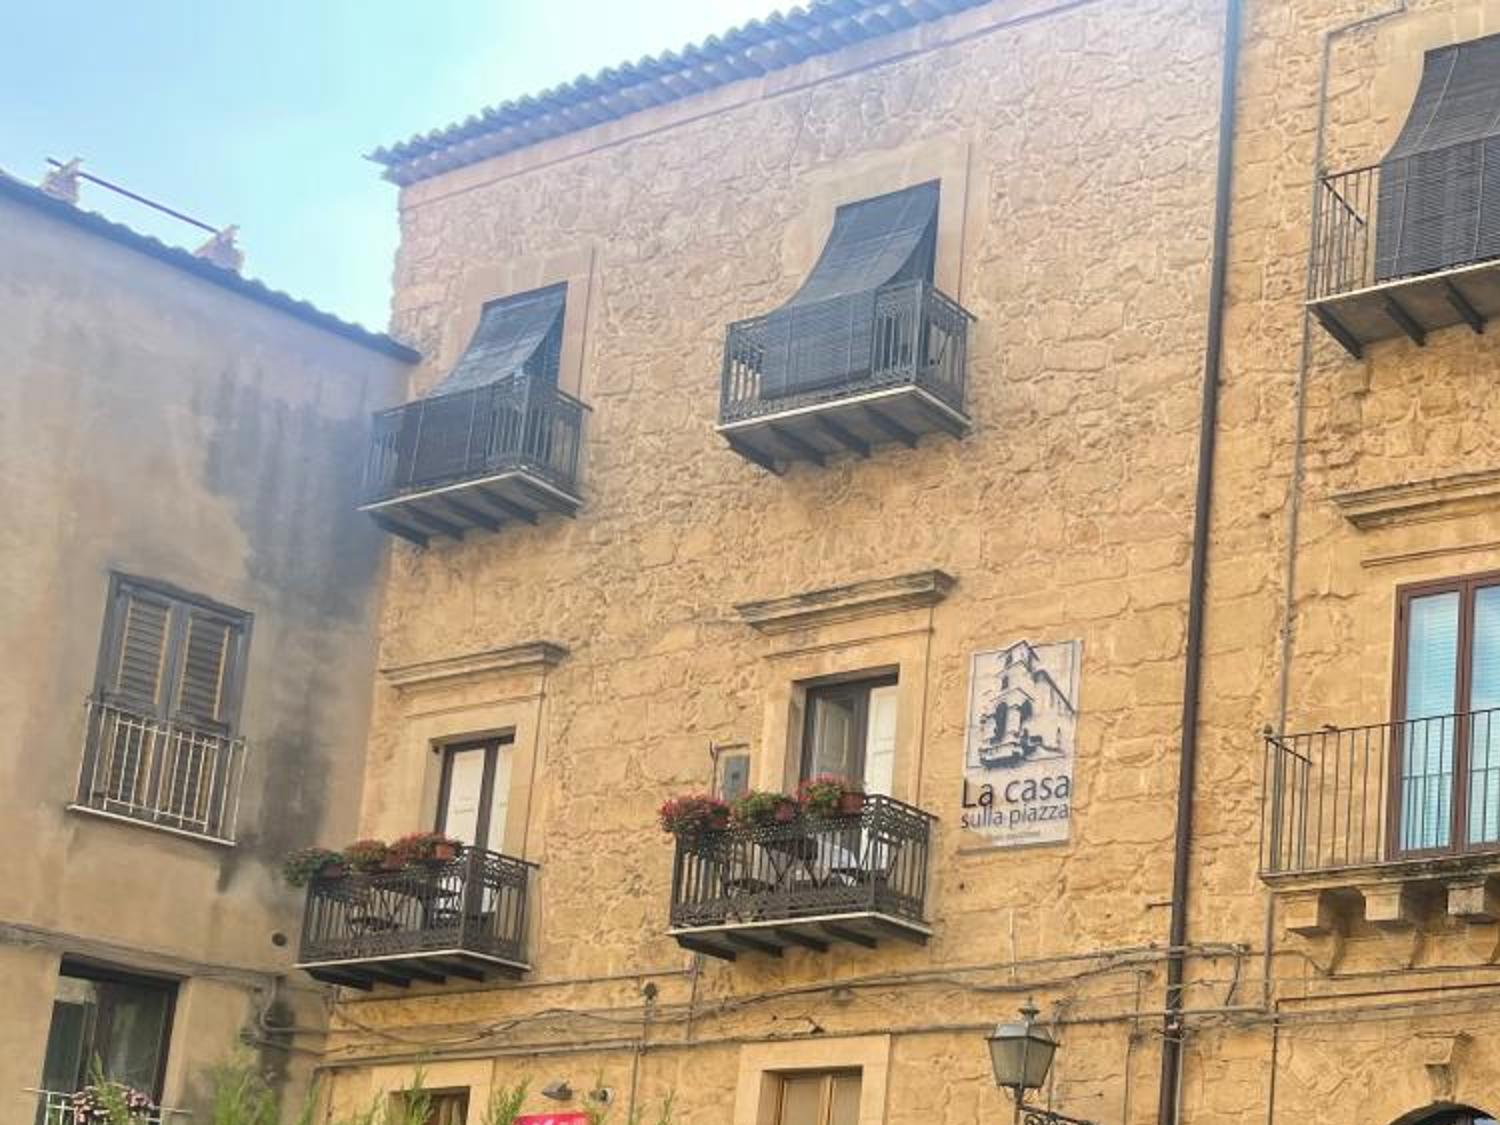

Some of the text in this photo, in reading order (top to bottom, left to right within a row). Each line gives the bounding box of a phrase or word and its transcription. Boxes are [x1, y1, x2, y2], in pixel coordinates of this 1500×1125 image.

[962, 775, 1070, 808] La casa
[961, 803, 1069, 830] sulla piazza
